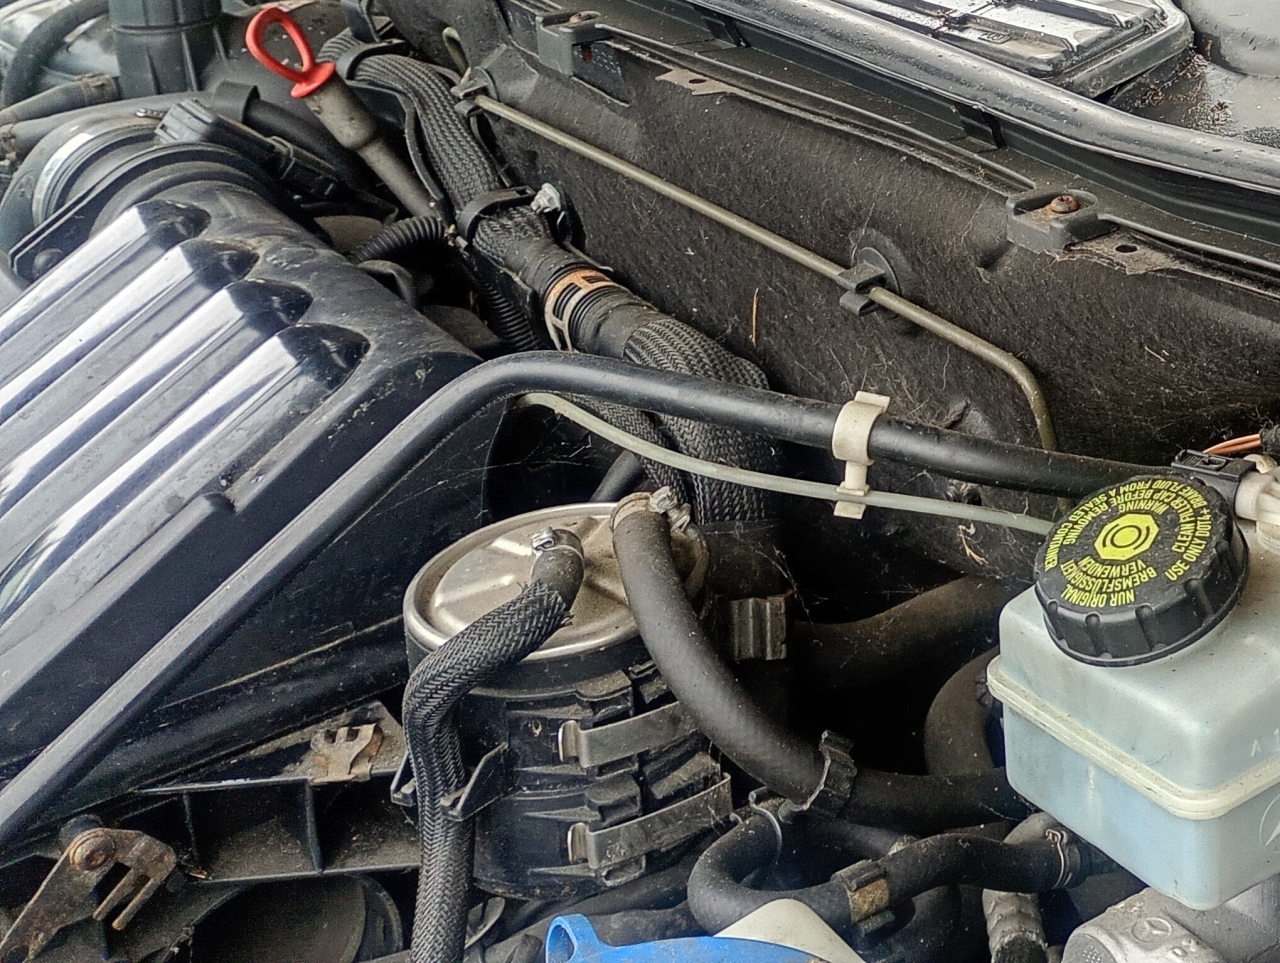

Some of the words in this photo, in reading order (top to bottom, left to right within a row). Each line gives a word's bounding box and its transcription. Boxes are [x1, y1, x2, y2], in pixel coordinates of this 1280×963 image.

[1120, 480, 1152, 494] FROM
[1152, 480, 1184, 492] FLUID
[1153, 490, 1176, 502] CAP
[1178, 486, 1207, 508] BRAKE
[1068, 494, 1107, 521] SEALED
[1109, 489, 1154, 507] BEFORE
[1118, 500, 1169, 515] WARNING
[1170, 496, 1196, 522] FILLER
[1063, 502, 1108, 545] REMOVING
[1044, 522, 1073, 572] CONTAINER
[1172, 523, 1195, 552] CLEAN
[1183, 537, 1207, 562] ONLY
[1078, 556, 1146, 578] VERWENDEN
[1164, 560, 1190, 581] USE
[1060, 584, 1107, 607] ORIGINAL
[1110, 589, 1135, 606] NUR
